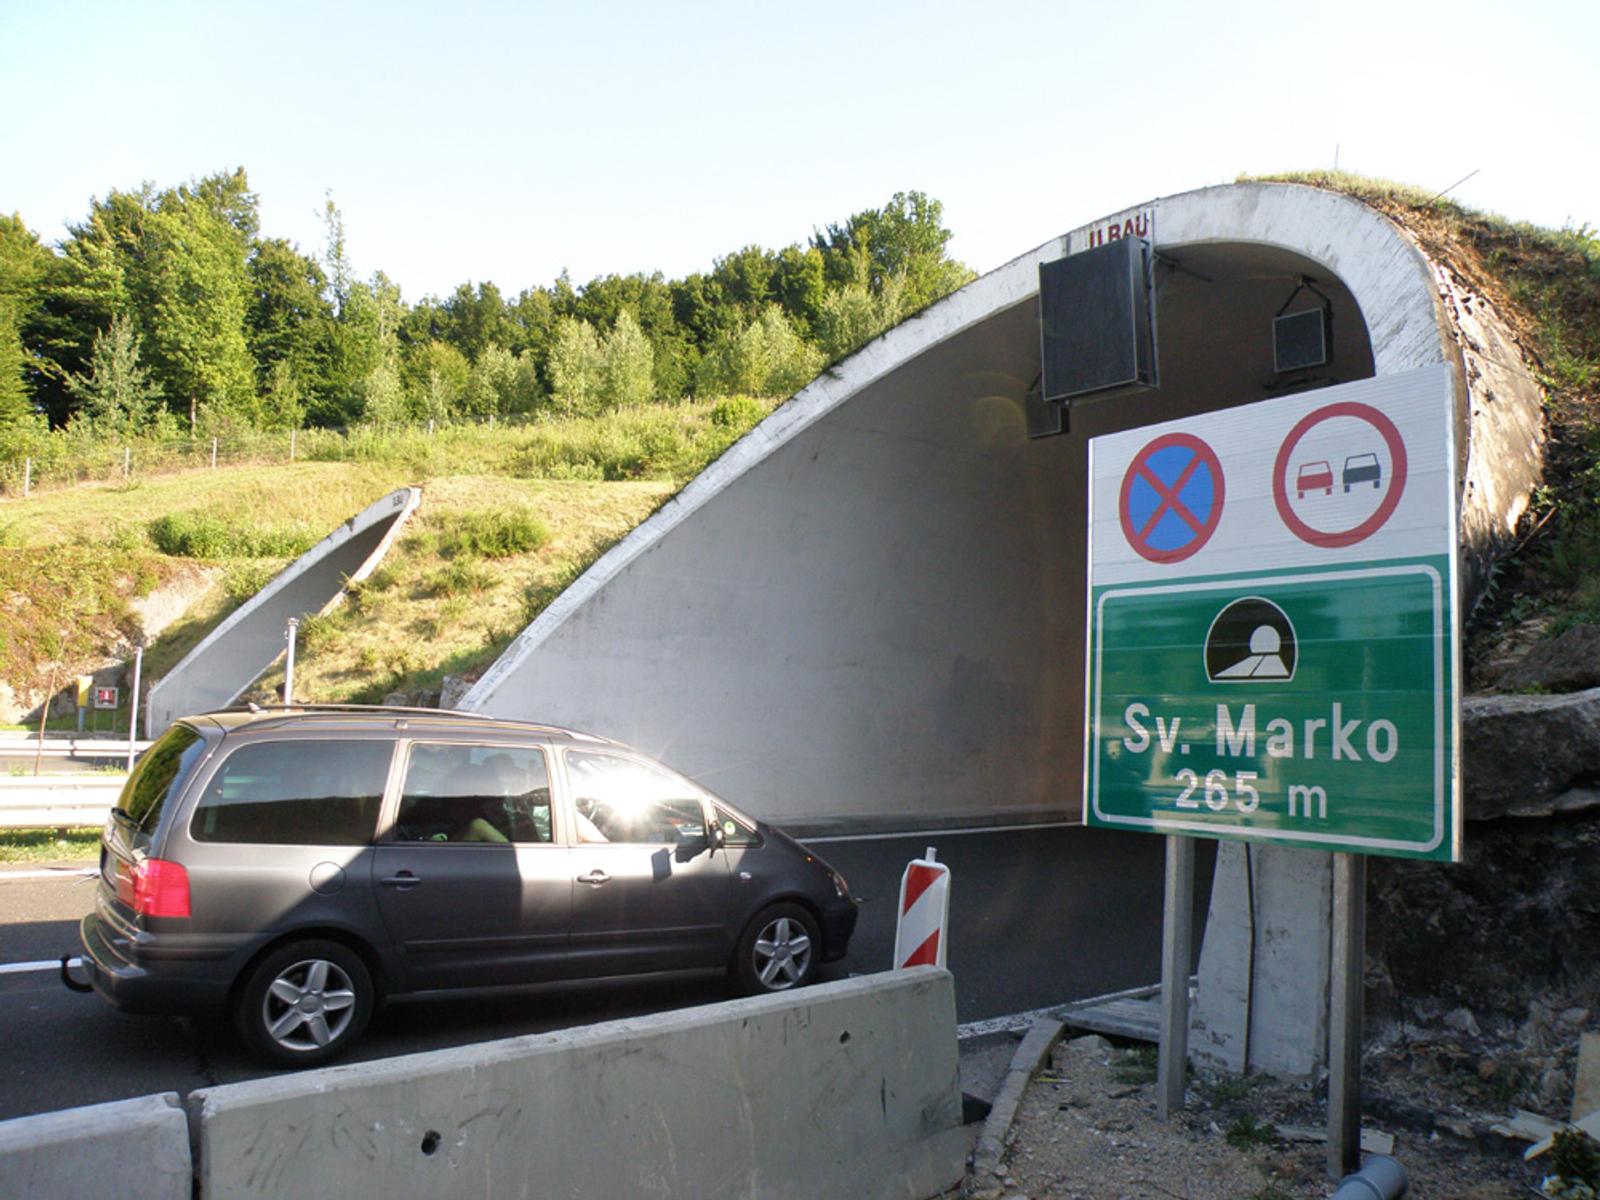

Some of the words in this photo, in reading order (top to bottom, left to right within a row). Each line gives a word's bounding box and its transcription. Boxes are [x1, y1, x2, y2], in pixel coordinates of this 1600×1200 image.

[1123, 702, 1190, 755] Sv.
[1215, 702, 1399, 763] Marko
[1175, 768, 1260, 813] 265
[1288, 784, 1328, 819] m
